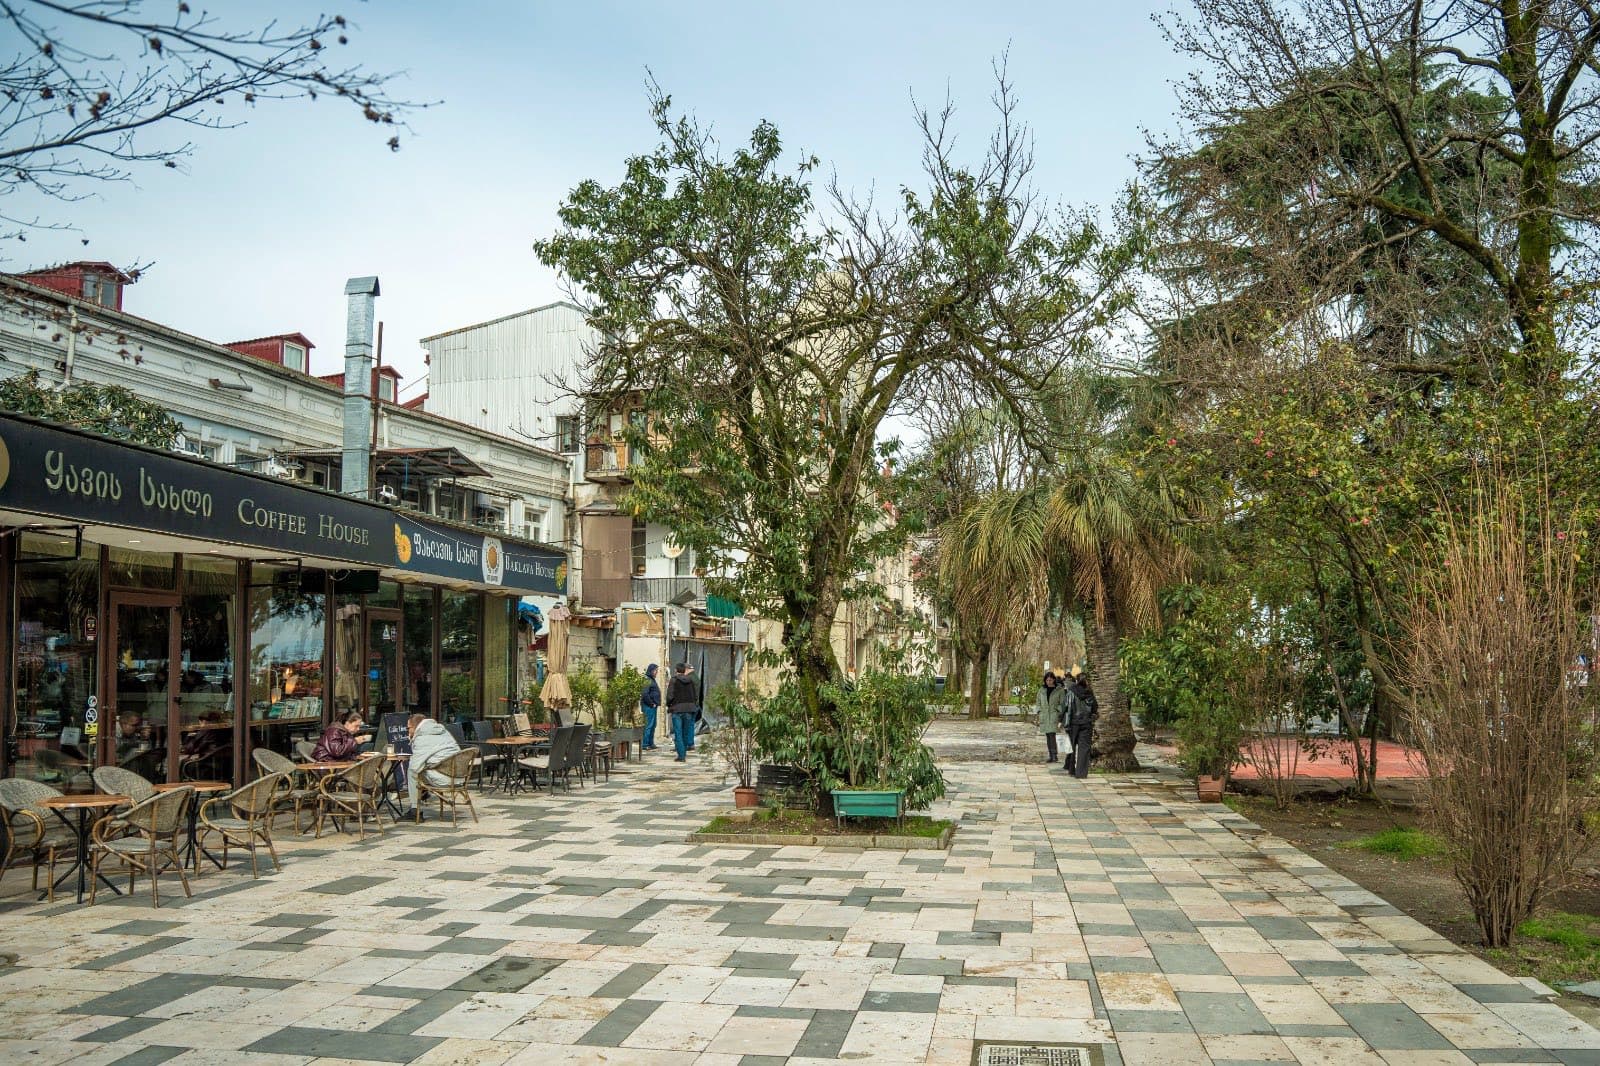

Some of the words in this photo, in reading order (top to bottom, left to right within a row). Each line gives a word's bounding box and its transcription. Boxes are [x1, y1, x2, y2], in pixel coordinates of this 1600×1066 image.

[45, 450, 122, 500] ყავის
[140, 467, 212, 516] სახლი
[237, 498, 307, 535] COFFEE
[317, 513, 369, 546] HOUSE
[413, 532, 453, 562] ფახლავის
[456, 540, 478, 566] სახლი
